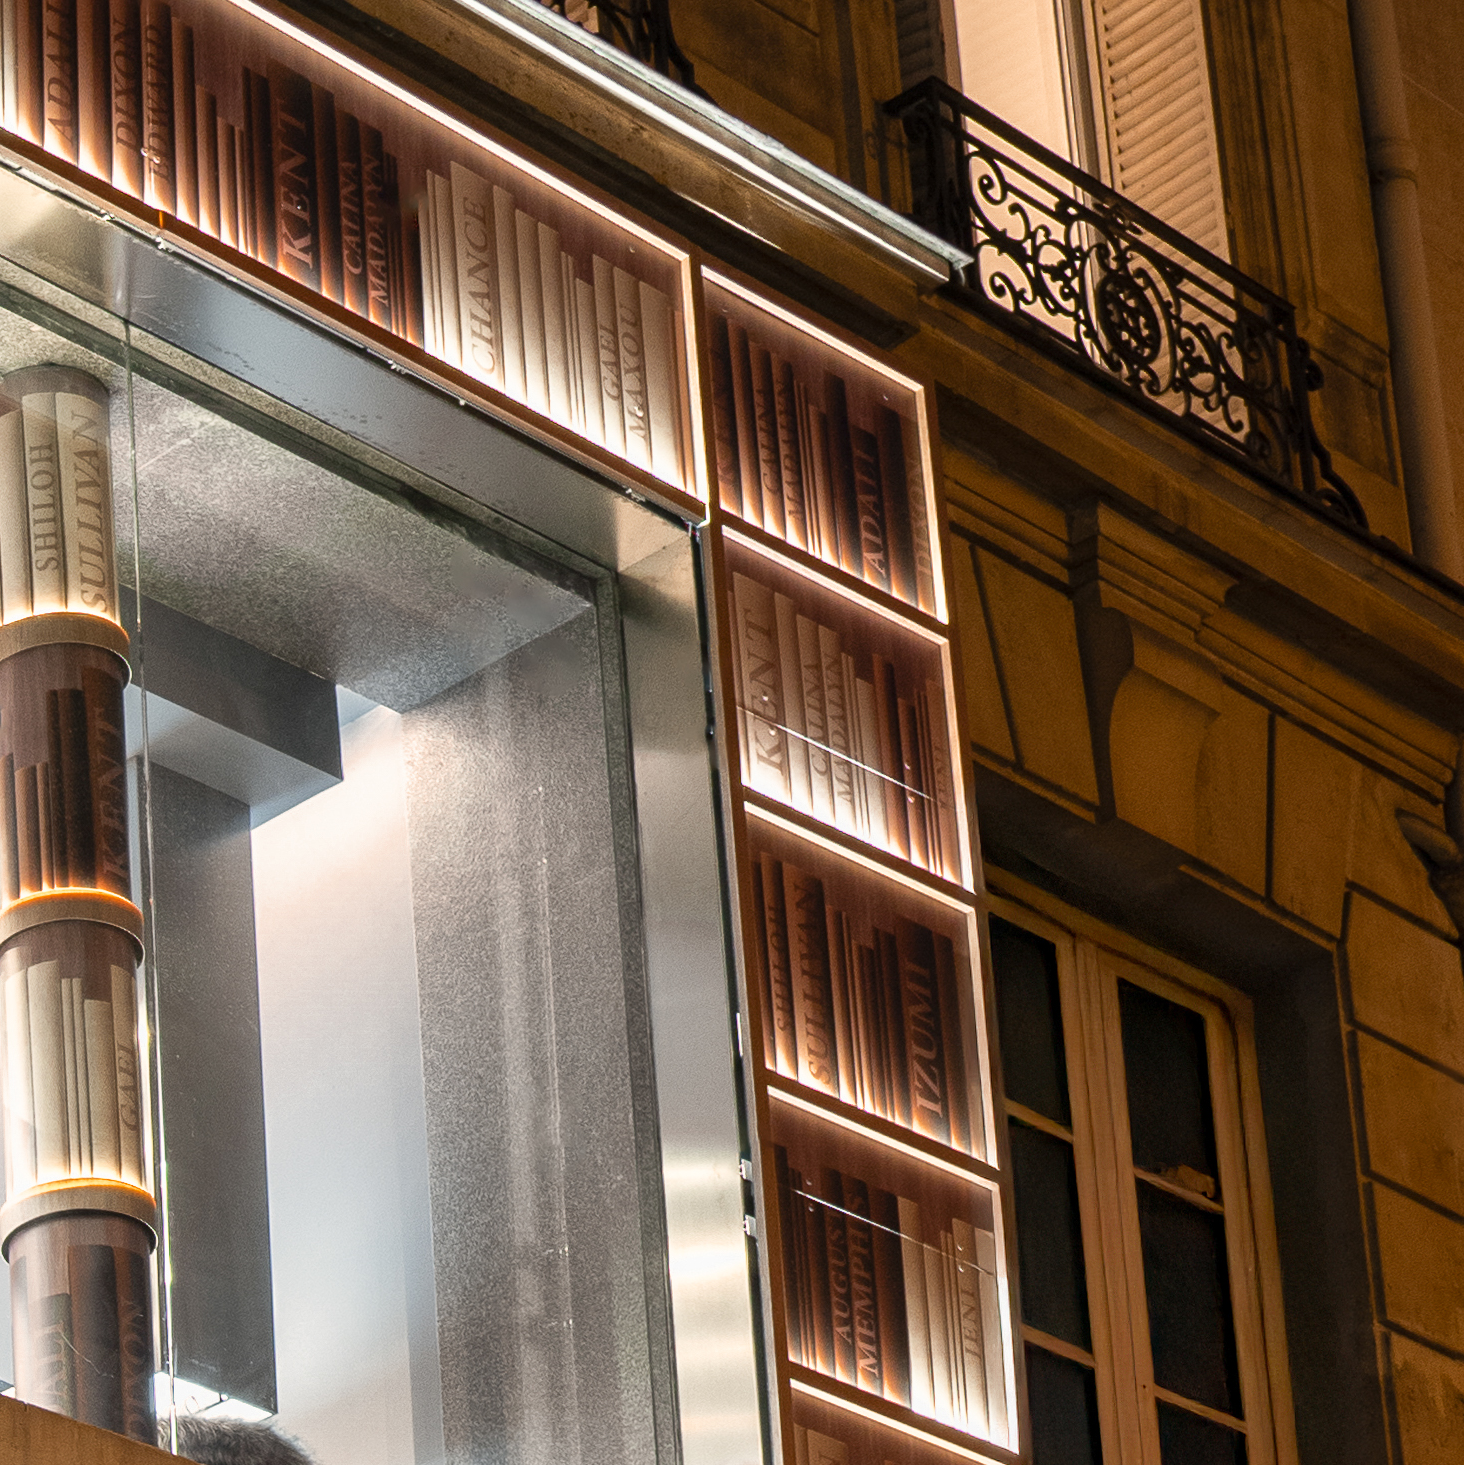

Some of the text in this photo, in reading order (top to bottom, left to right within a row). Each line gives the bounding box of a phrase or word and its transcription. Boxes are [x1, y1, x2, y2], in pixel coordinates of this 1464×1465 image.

[113, 13, 139, 152] DIXON
[277, 94, 314, 269] KENT
[341, 158, 363, 276] CALINA
[462, 196, 496, 375] CHANCE
[620, 300, 646, 443] MAXOU
[29, 442, 60, 572] SHILOH
[71, 411, 106, 613] SULLIVAN
[854, 446, 887, 578] ADALI
[745, 608, 785, 776] KENT
[803, 661, 828, 776] CALINA
[768, 903, 793, 1032] SHILOH
[793, 882, 831, 1086] SULLIVAN
[904, 957, 943, 1118] IZUMI
[961, 1287, 981, 1361] JENI
